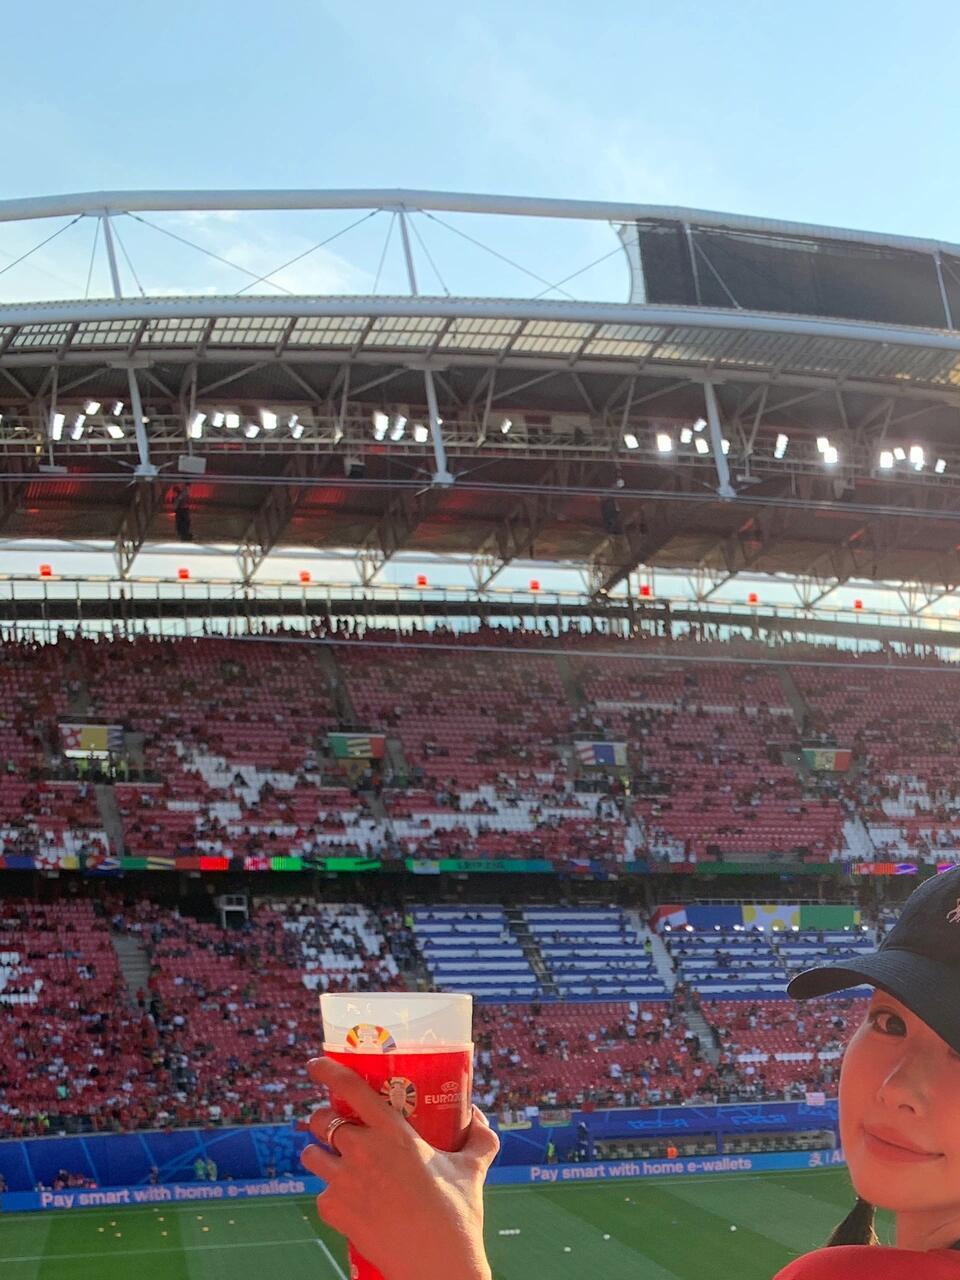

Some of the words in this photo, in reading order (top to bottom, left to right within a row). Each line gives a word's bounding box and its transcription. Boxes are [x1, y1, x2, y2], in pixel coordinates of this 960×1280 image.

[531, 1167, 561, 1182] Pay
[562, 1166, 606, 1179] smart
[608, 1161, 640, 1177] with
[643, 1161, 684, 1175] home
[687, 1159, 753, 1173] e-wallets
[41, 1192, 74, 1209] Pay
[79, 1189, 131, 1205] smart
[134, 1184, 171, 1201] with
[175, 1183, 223, 1199] home
[228, 1180, 305, 1196] e-wallets
